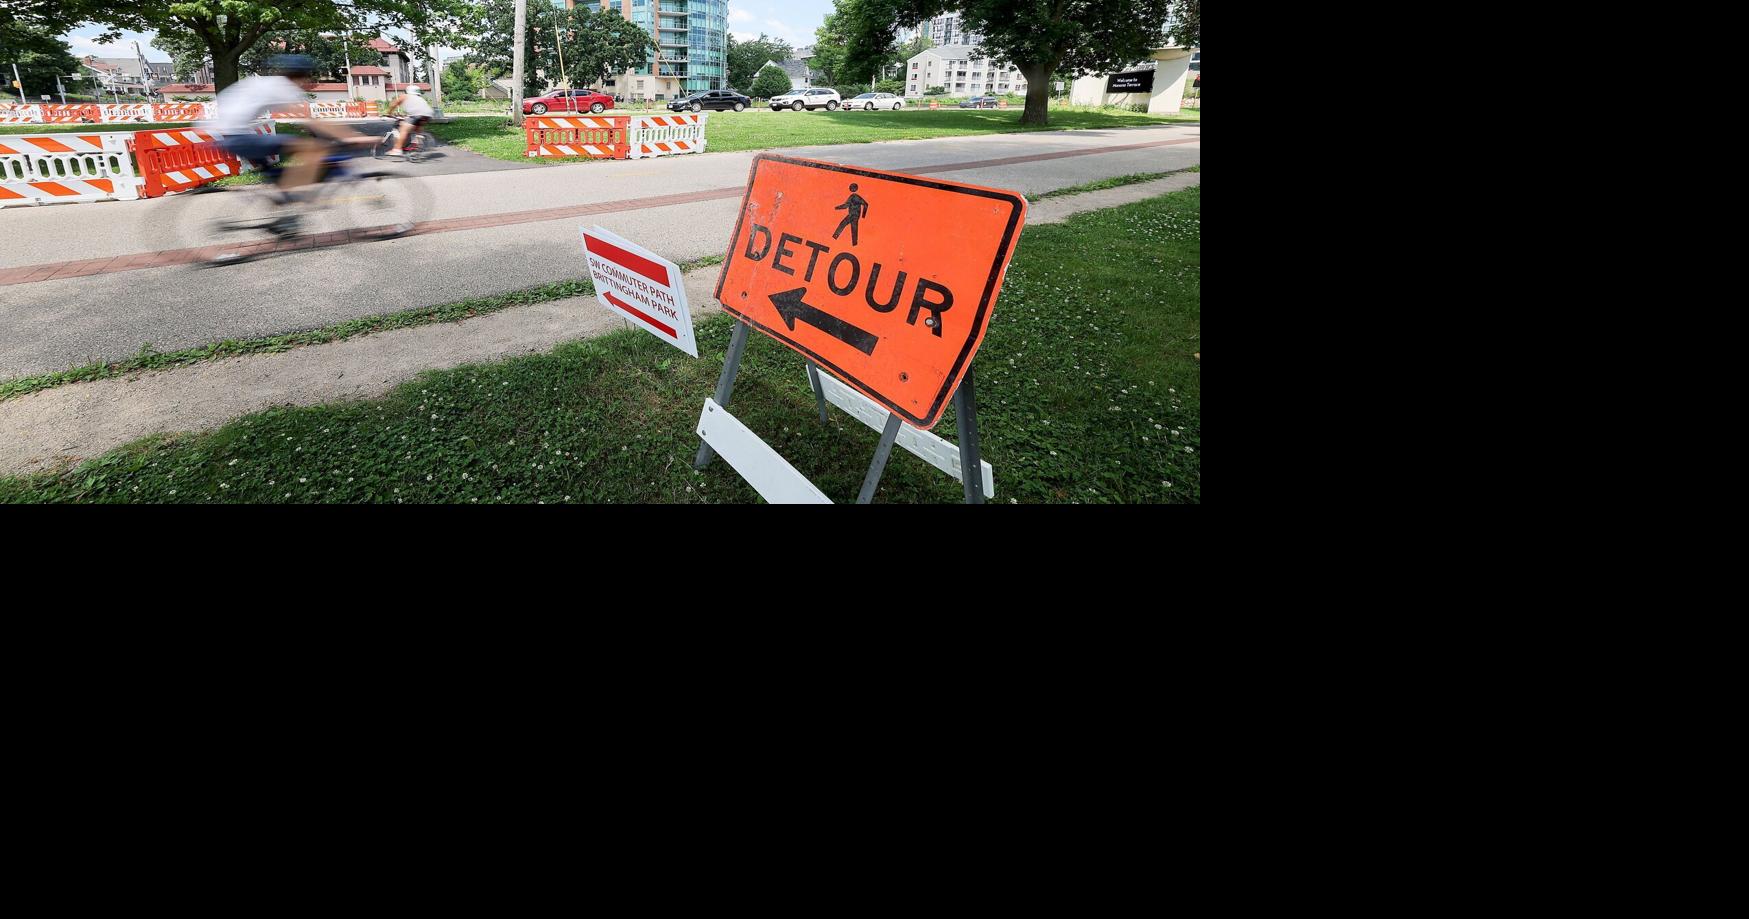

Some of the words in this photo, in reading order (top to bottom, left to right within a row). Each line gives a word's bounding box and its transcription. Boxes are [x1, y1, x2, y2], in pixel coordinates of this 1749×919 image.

[589, 257, 601, 270] SW
[601, 264, 649, 294] COMMUTER
[650, 287, 675, 306] PATH
[592, 270, 650, 305] BRITTINGHAM
[651, 301, 679, 321] PARK
[744, 223, 954, 338] DETOUR
